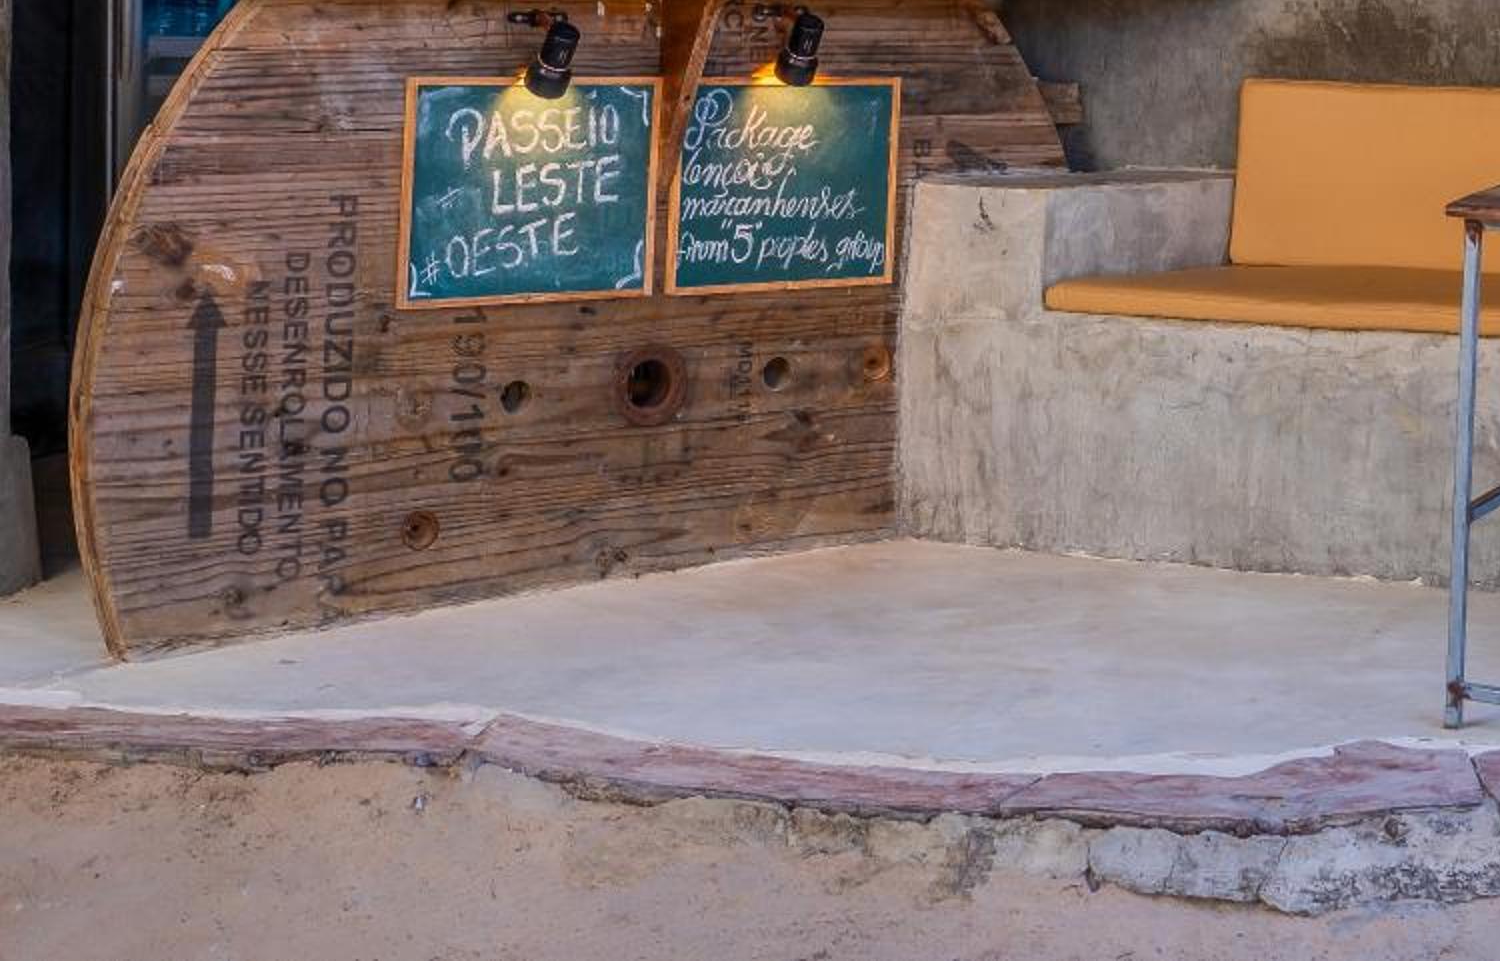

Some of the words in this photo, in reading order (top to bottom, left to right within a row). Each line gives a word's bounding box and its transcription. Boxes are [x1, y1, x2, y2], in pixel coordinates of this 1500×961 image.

[446, 103, 620, 170] PASSEIO
[683, 89, 822, 156] Package
[492, 154, 621, 215] LESTE
[241, 280, 271, 396] NESSE
[320, 194, 358, 434] PRODUZIDO
[276, 252, 310, 581] DESENROLAMENTO
[238, 402, 267, 556] SENTIDO
[319, 446, 350, 508] NO
